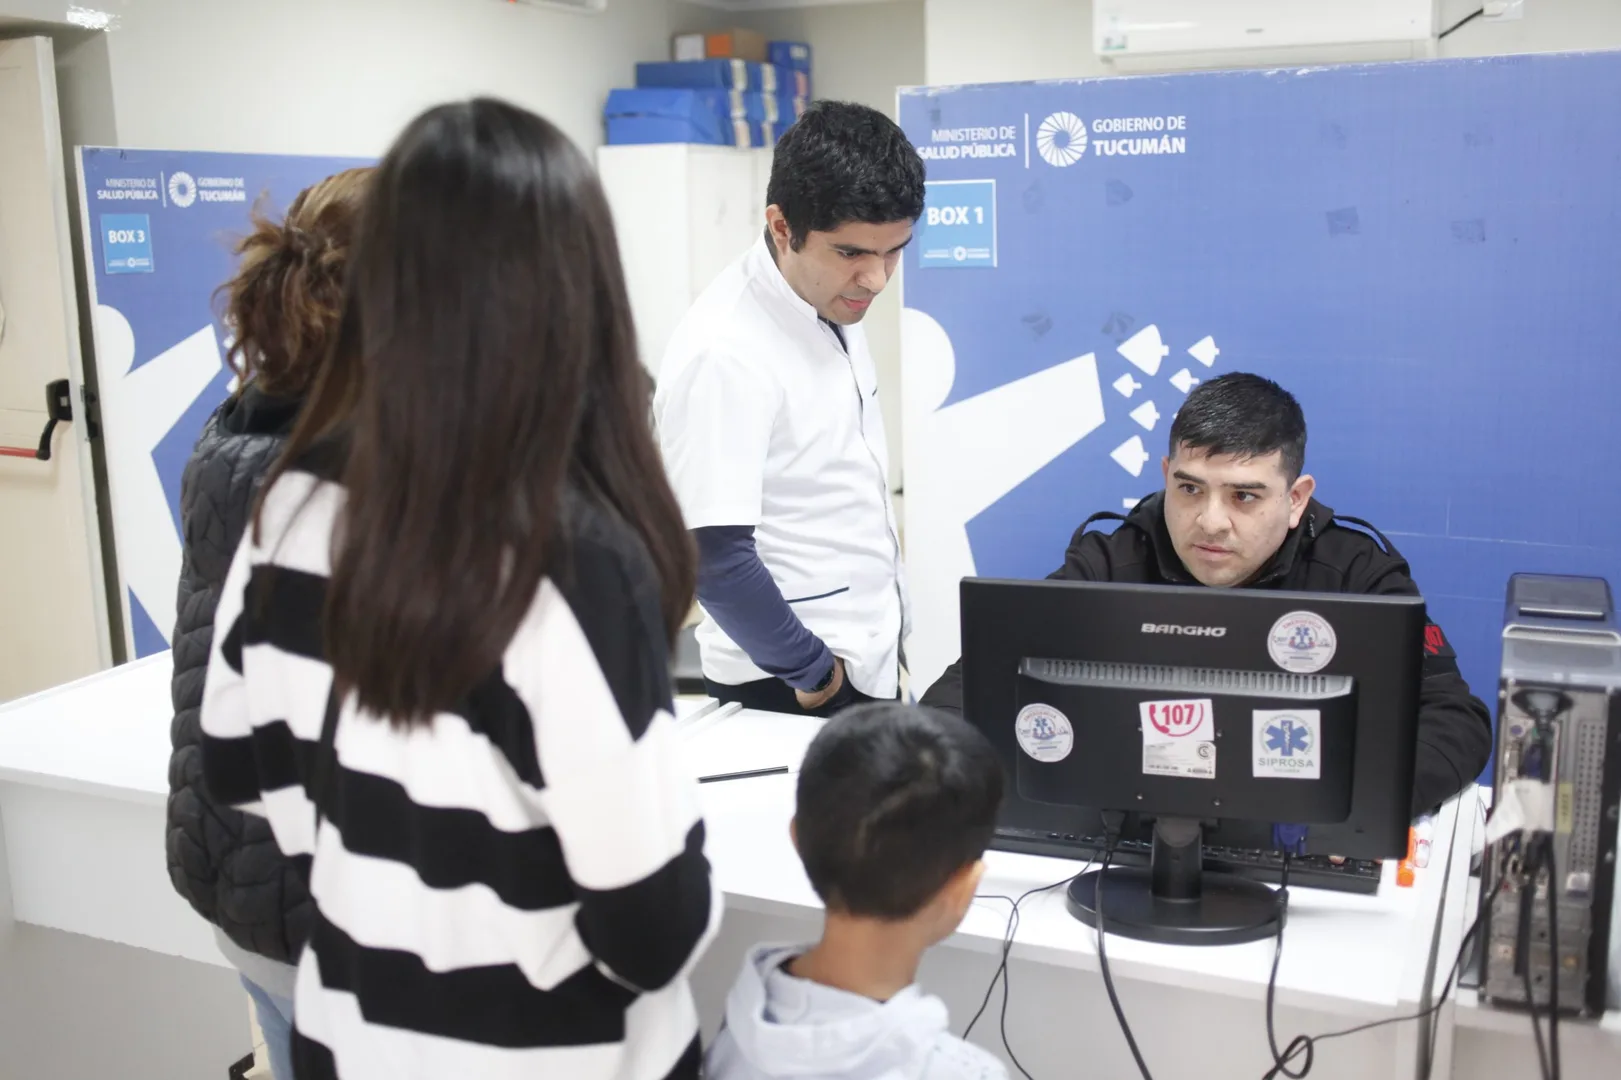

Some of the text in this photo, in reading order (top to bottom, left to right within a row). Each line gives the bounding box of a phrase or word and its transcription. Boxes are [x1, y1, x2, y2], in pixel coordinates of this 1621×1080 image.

[1092, 115, 1187, 134] GOBIERNO DE
[931, 125, 1016, 143] MINISTERIO DE
[916, 142, 1016, 160] SALUD PÚBLICA
[1092, 134, 1187, 156] TUCUMÁN
[96, 189, 124, 200] SALUD
[926, 206, 984, 226] BOX 1
[108, 230, 146, 244] BOX 3
[1161, 704, 1196, 726] 107
[1258, 757, 1315, 768] SIPROSA
